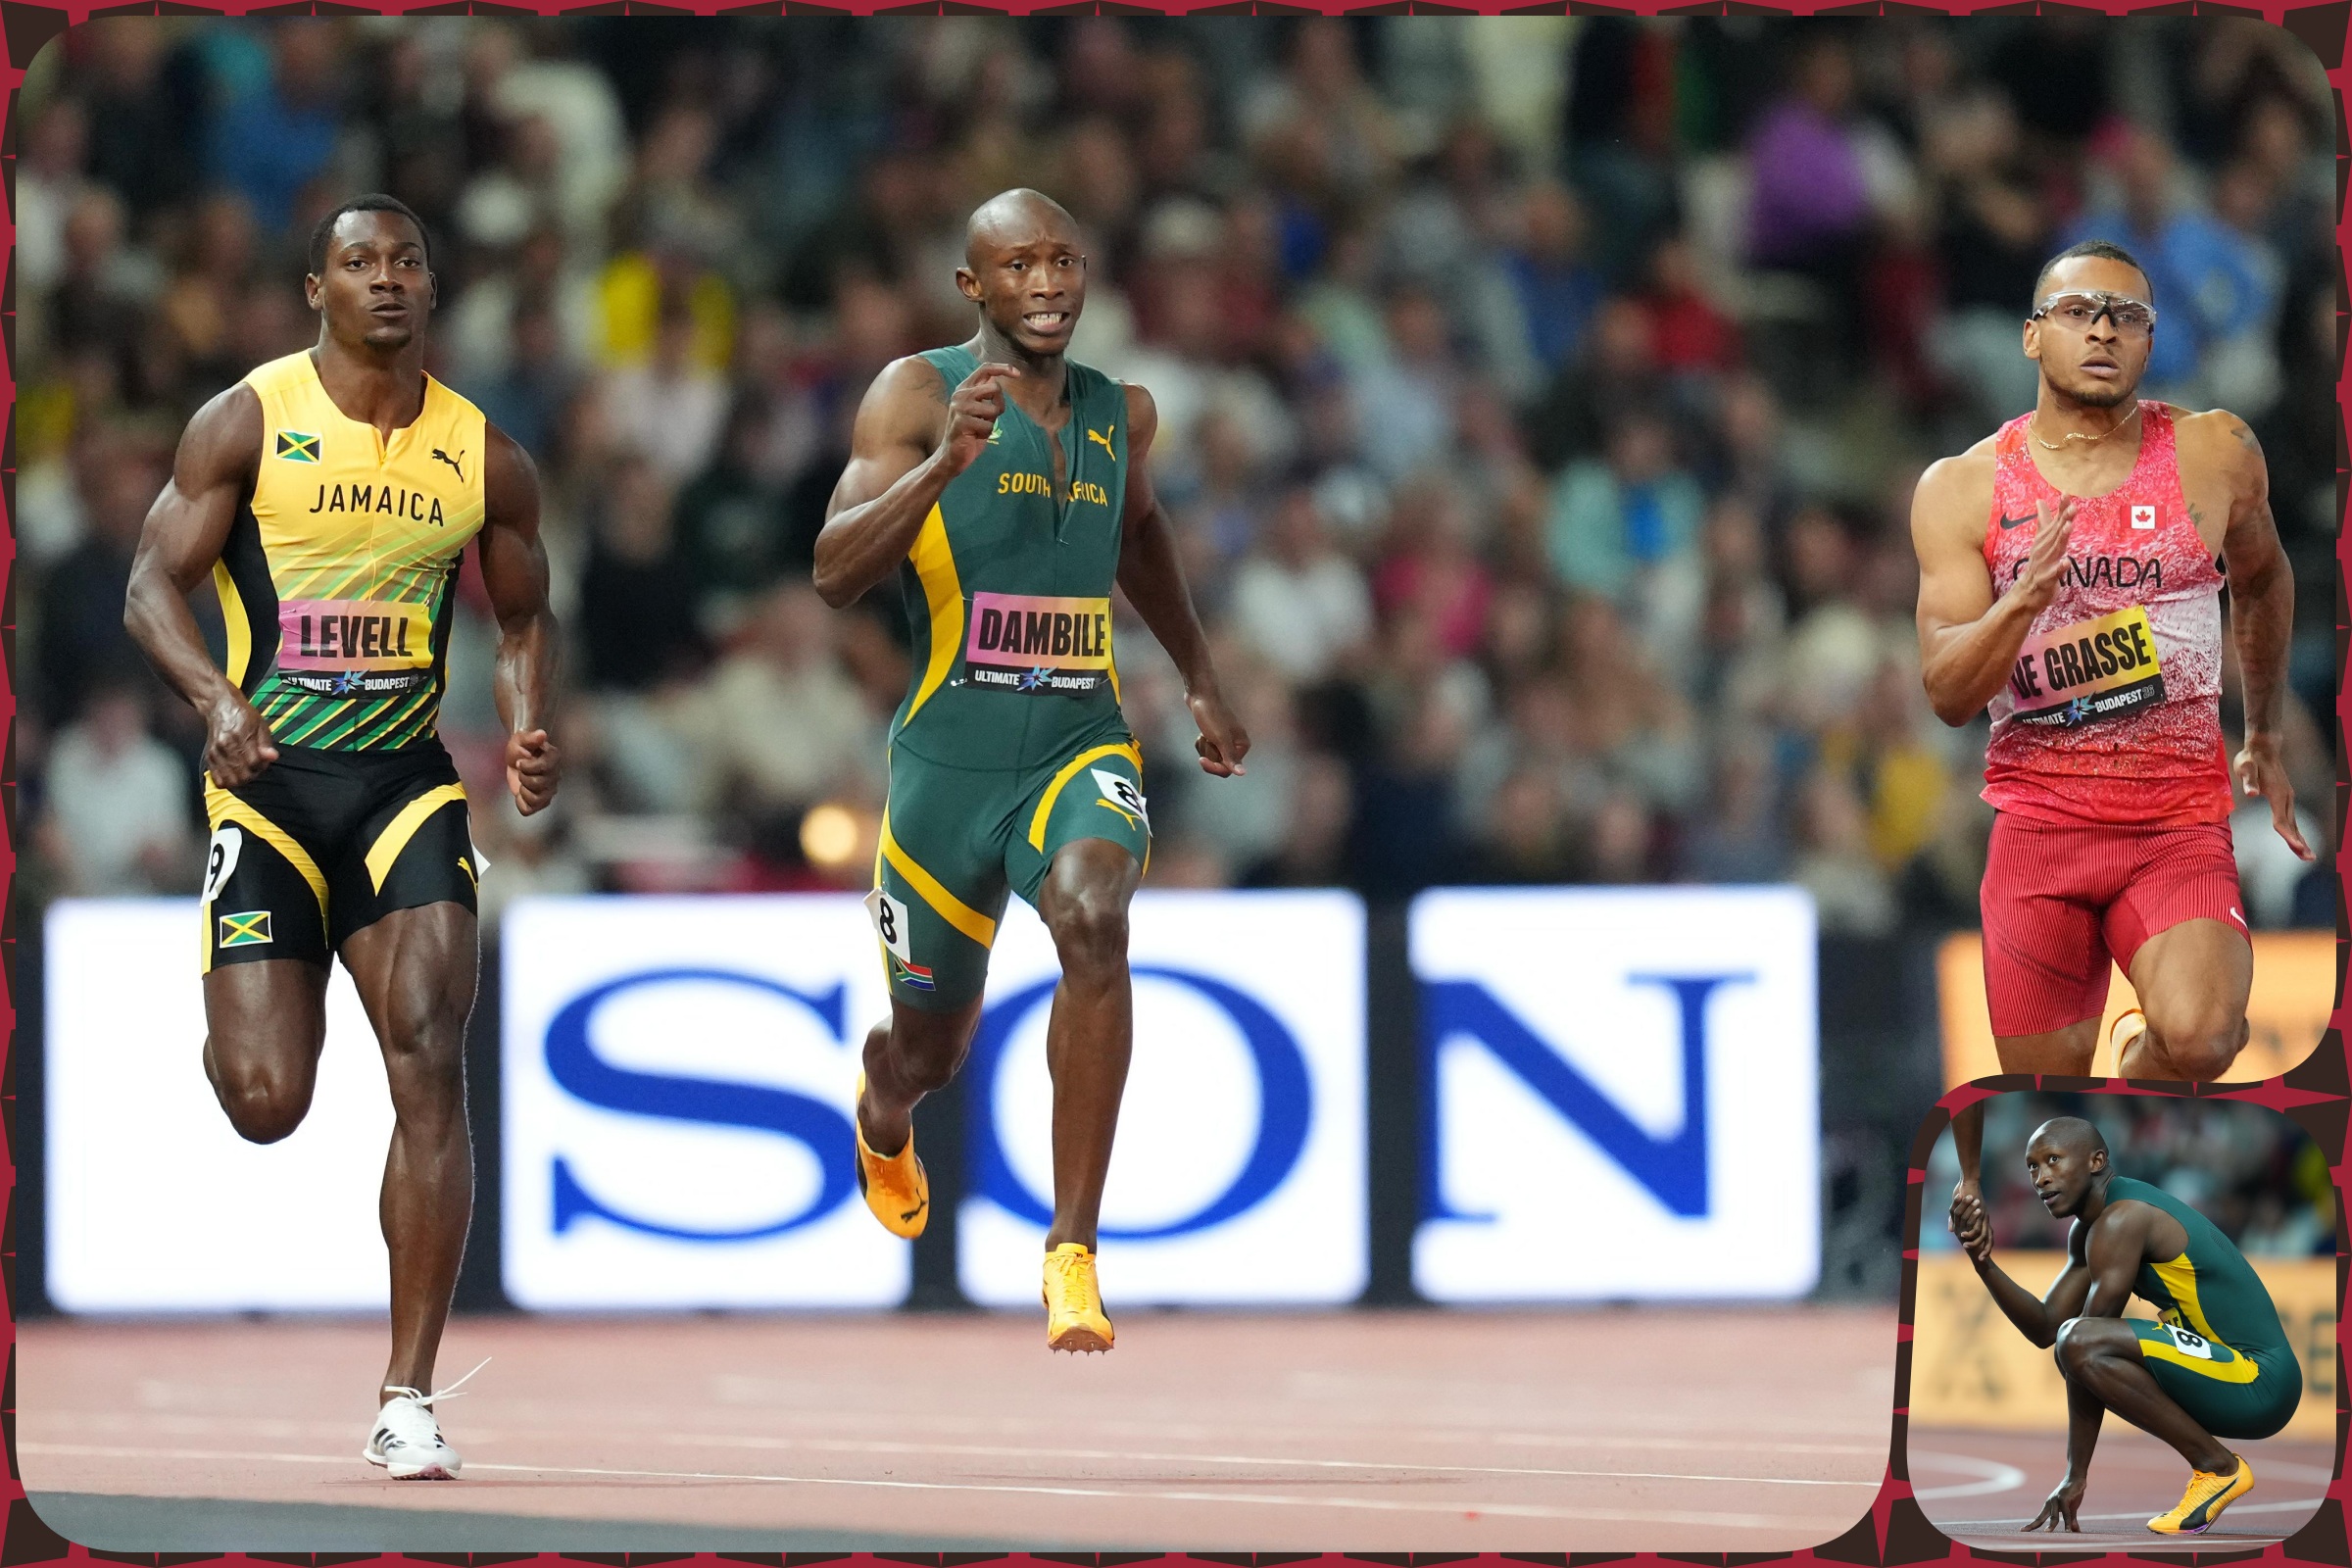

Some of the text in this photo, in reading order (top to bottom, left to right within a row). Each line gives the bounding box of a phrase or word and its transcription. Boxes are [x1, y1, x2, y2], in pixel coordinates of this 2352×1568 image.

[998, 472, 1051, 498] SOUTH
[310, 484, 444, 526] JAMAICA
[2013, 556, 2162, 588] CNADA
[300, 614, 414, 659] LEVELL
[978, 608, 1105, 658] DAMBILE
[2044, 621, 2151, 692] GRASSE
[365, 676, 410, 691] BUDAPEST
[974, 669, 1020, 685] ULTIMATE
[1052, 676, 1095, 690] BUDAPEST
[2094, 689, 2142, 712] BUDAPEST
[1114, 781, 1143, 814] 8
[209, 843, 224, 893] 9
[880, 897, 897, 945] 8
[544, 967, 1755, 1241] SON
[2177, 1331, 2202, 1348] 8
